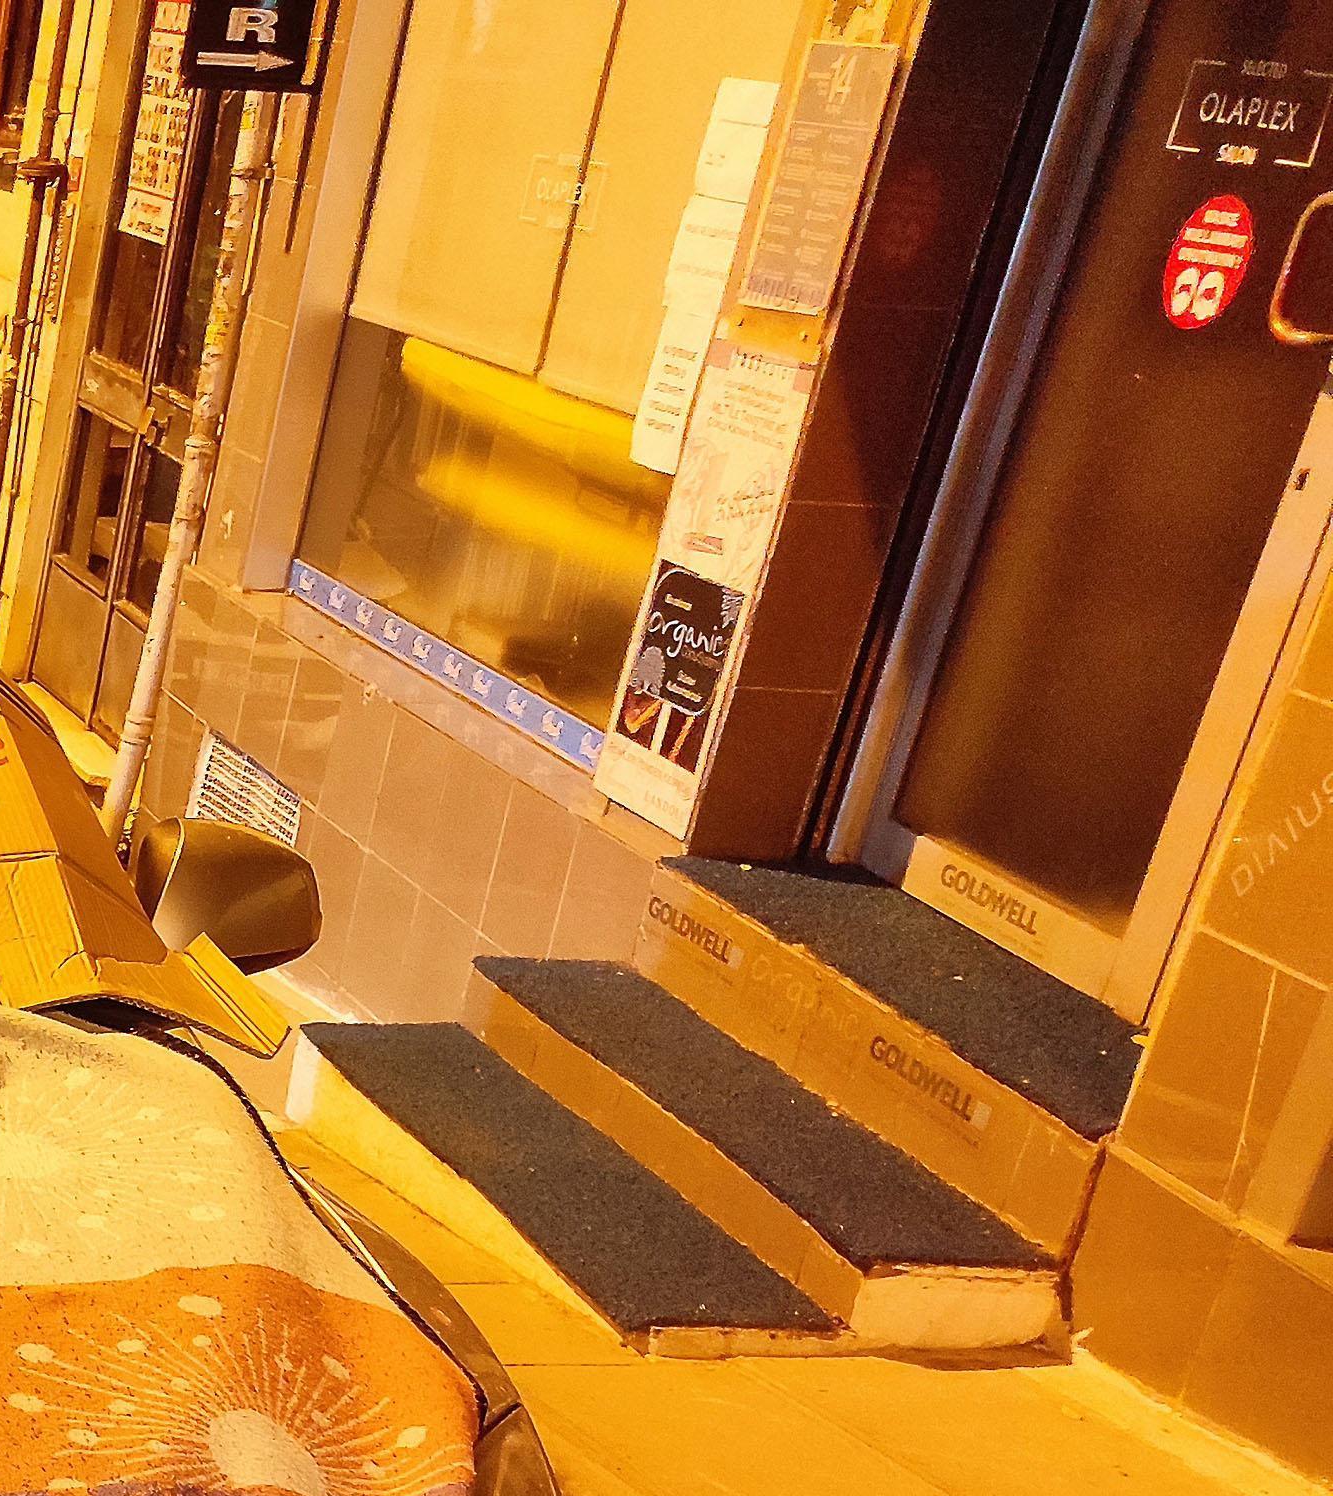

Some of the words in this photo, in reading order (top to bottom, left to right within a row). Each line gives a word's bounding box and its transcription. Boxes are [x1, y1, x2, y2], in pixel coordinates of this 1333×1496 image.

[225, 7, 280, 44] R
[1199, 92, 1301, 133] OLAPLEX
[647, 610, 726, 659] organic
[939, 862, 1040, 937] GOLDWELL
[648, 896, 733, 965] GOLDWELL
[869, 1035, 976, 1122] GOLDWELL
